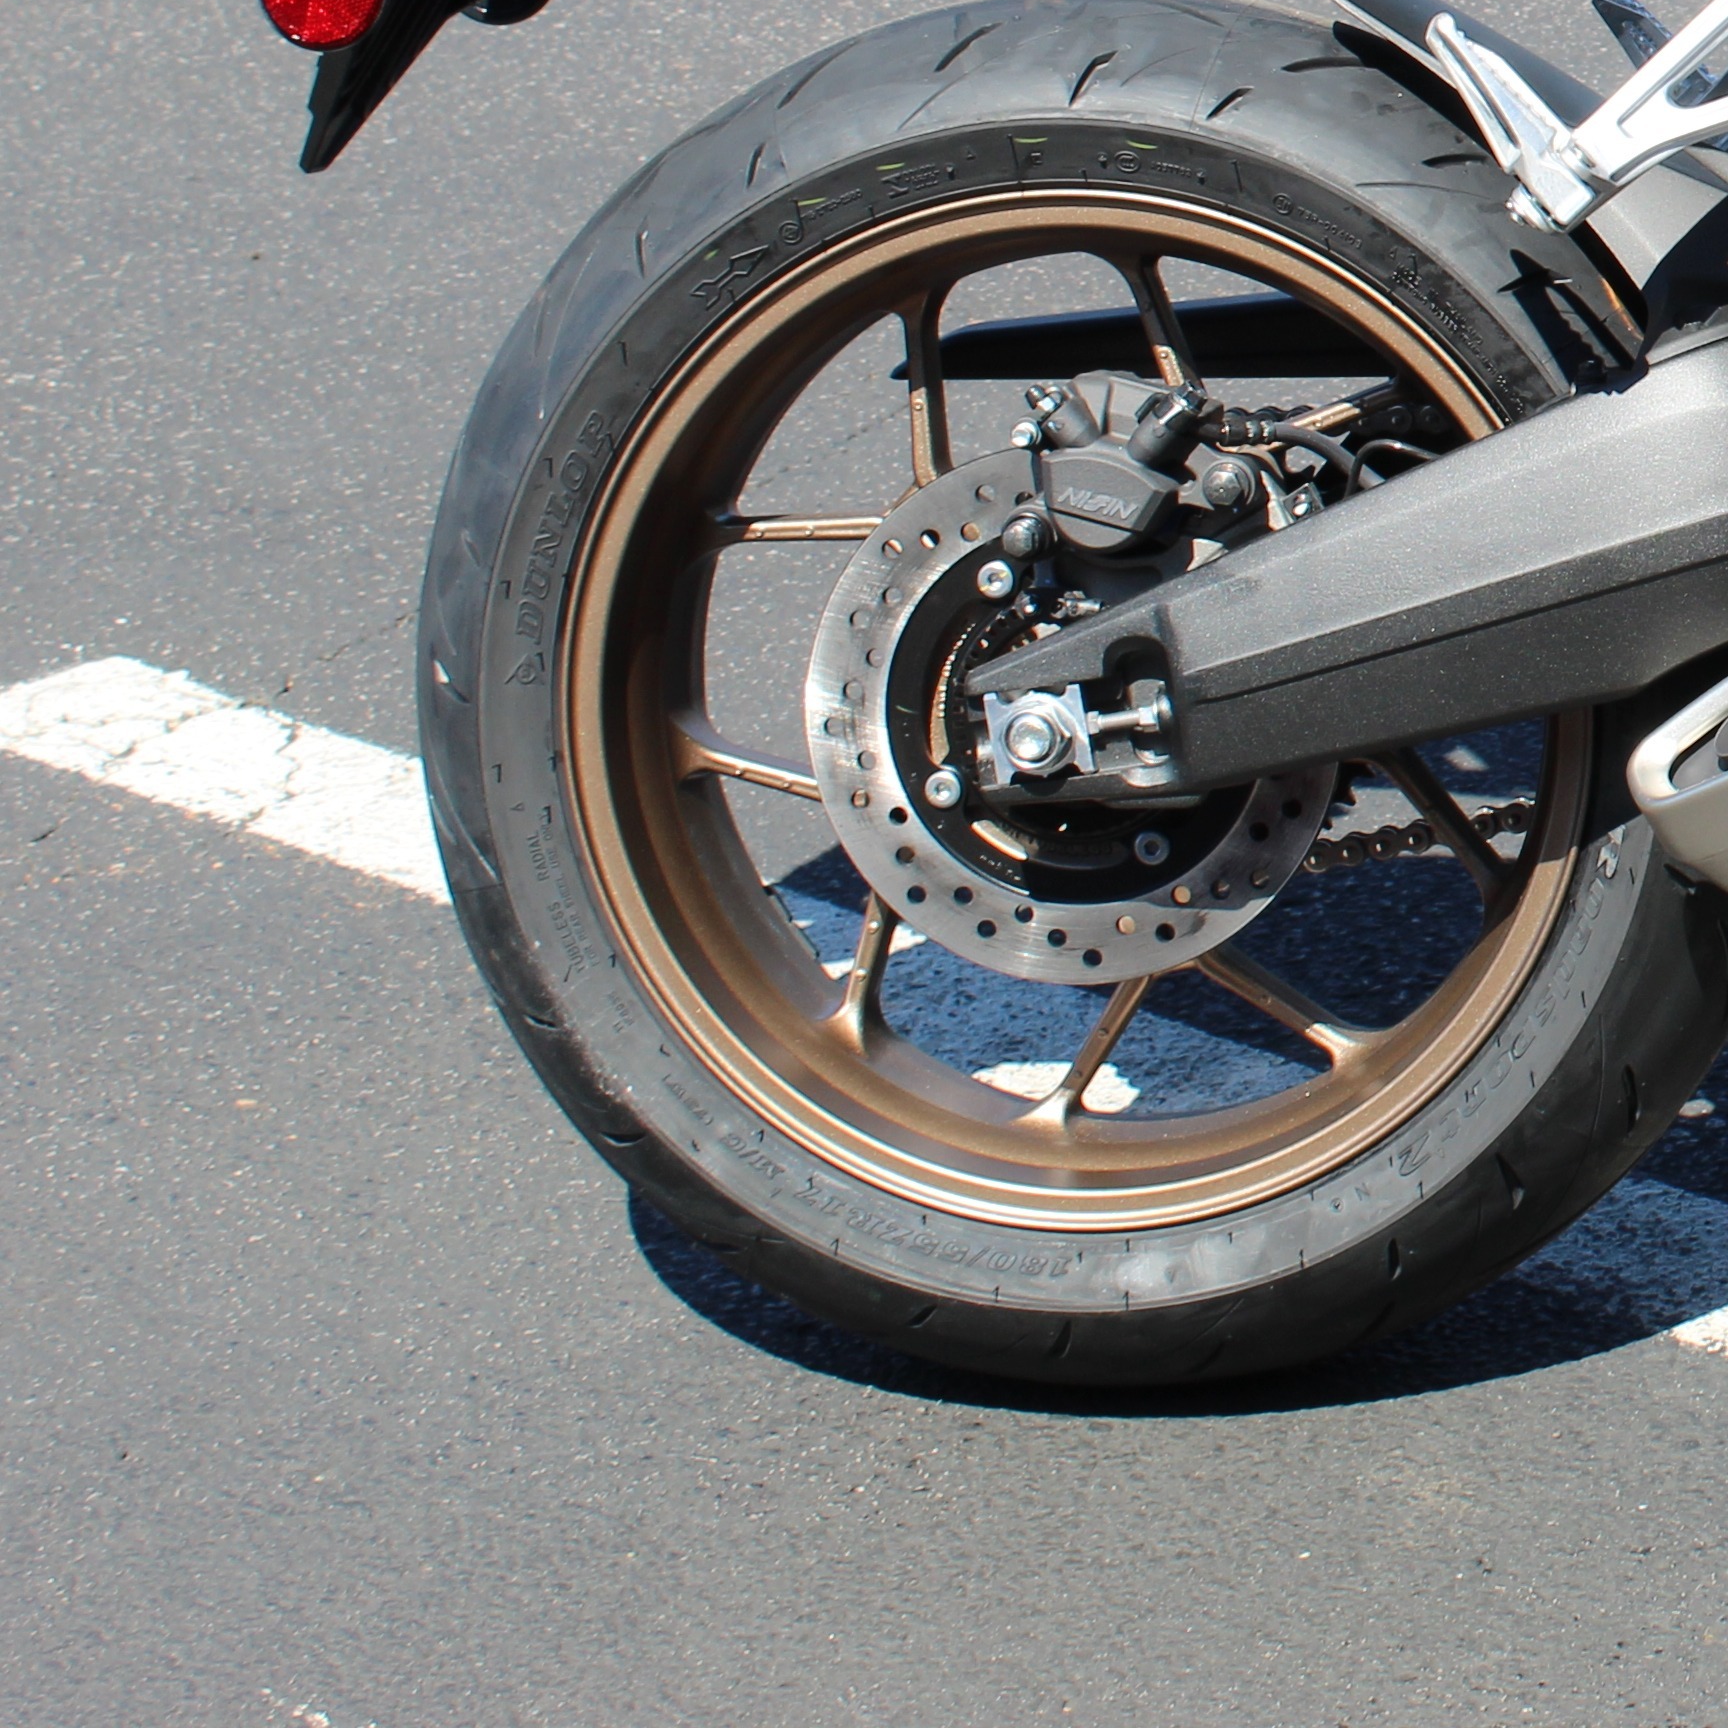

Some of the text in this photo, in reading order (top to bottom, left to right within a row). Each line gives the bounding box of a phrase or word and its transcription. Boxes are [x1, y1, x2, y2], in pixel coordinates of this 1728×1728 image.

[512, 406, 617, 645] DUNLOP
[545, 846, 561, 869] USE
[524, 829, 589, 975] TUBELESS RADIAL
[552, 872, 574, 909] WHEEL
[567, 912, 589, 943] REAR
[582, 944, 601, 969] FOR
[717, 1128, 786, 1186] M/C
[793, 1179, 1072, 1276] 180/55ZR17
